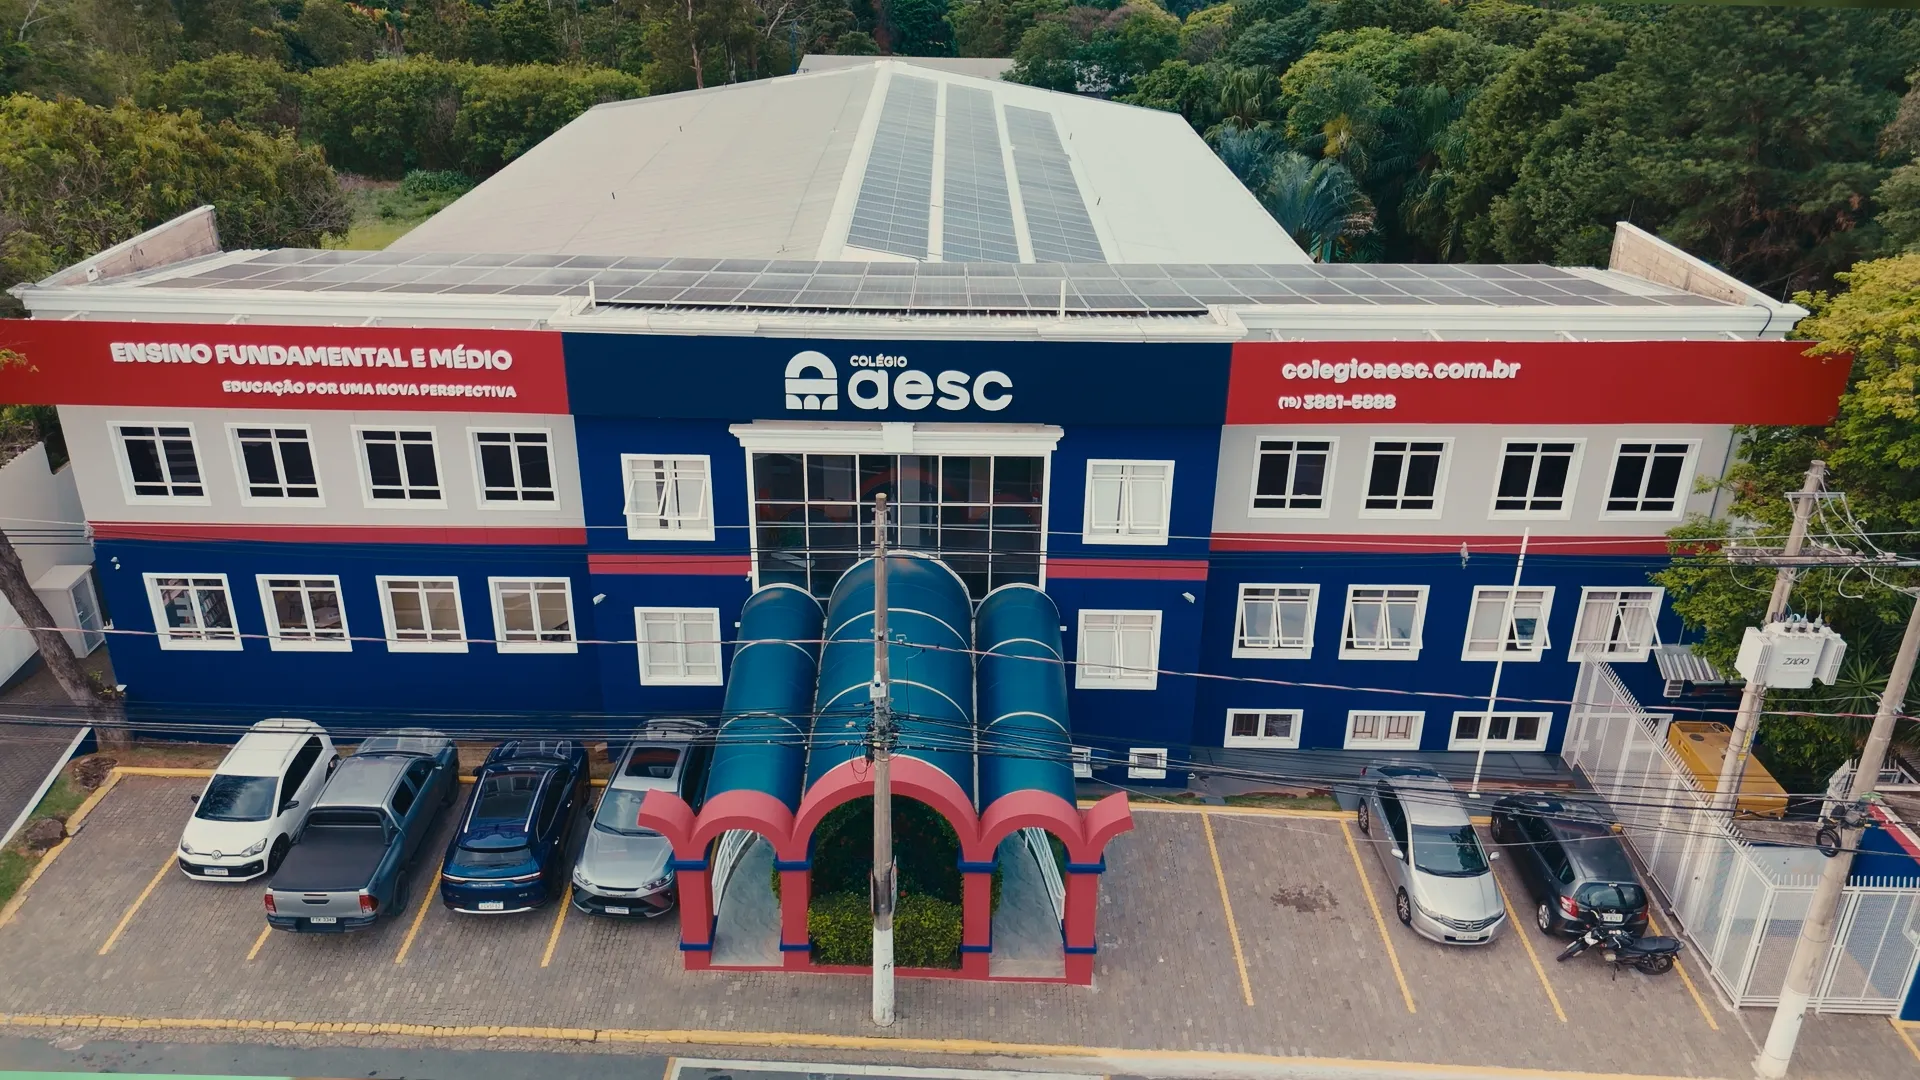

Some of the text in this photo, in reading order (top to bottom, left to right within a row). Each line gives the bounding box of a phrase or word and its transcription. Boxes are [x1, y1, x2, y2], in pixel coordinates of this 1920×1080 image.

[110, 342, 513, 371] ENSINO FUNDAMENTAL E MÉDIO
[850, 354, 907, 368] COLÉGIO
[1282, 358, 1521, 384] colegioaesc.com.br
[222, 379, 517, 398] EDUCAÇÃO POR UMA NOVA PERSPECTIVA
[847, 369, 1014, 412] aesc
[1278, 393, 1396, 410] (19) 3881-5888
